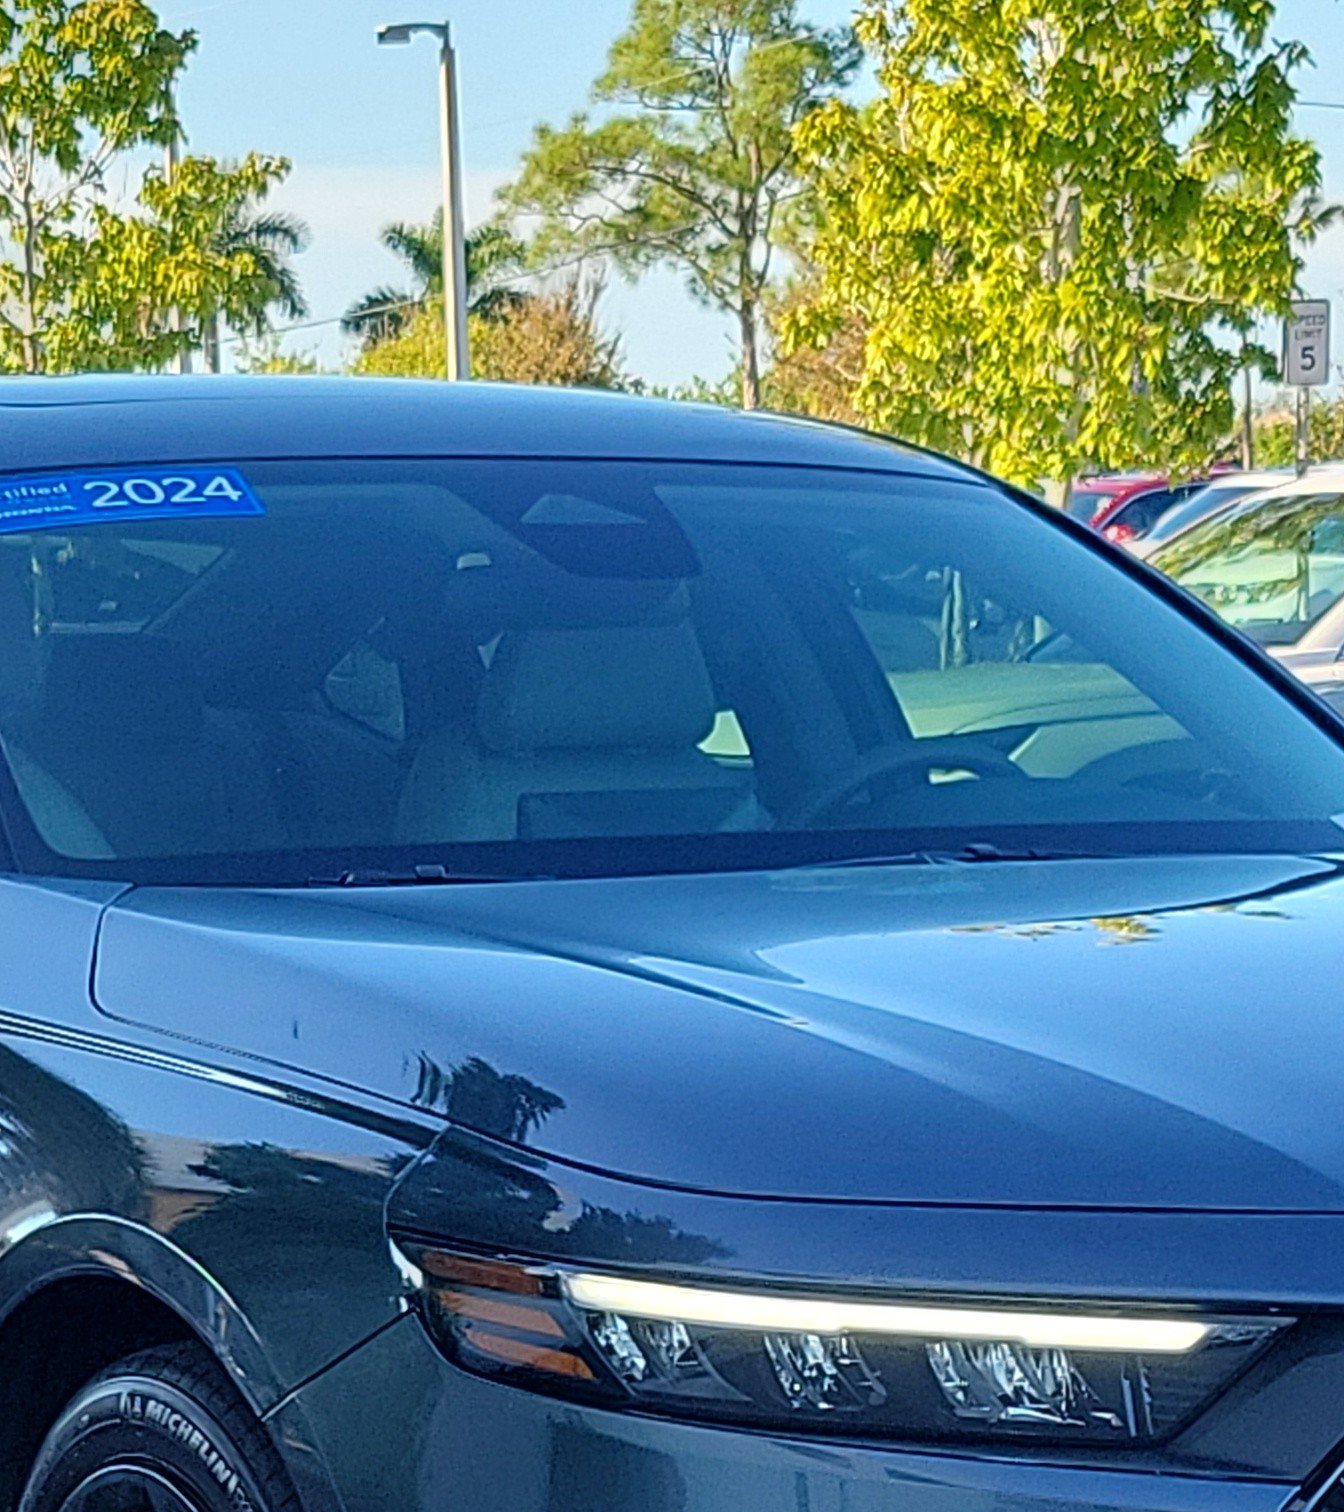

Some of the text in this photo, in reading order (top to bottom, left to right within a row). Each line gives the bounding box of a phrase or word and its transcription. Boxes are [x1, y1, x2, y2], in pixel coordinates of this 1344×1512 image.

[1300, 345, 1316, 371] 5
[83, 476, 243, 508] 2024
[144, 1398, 233, 1485] MICHELIN
